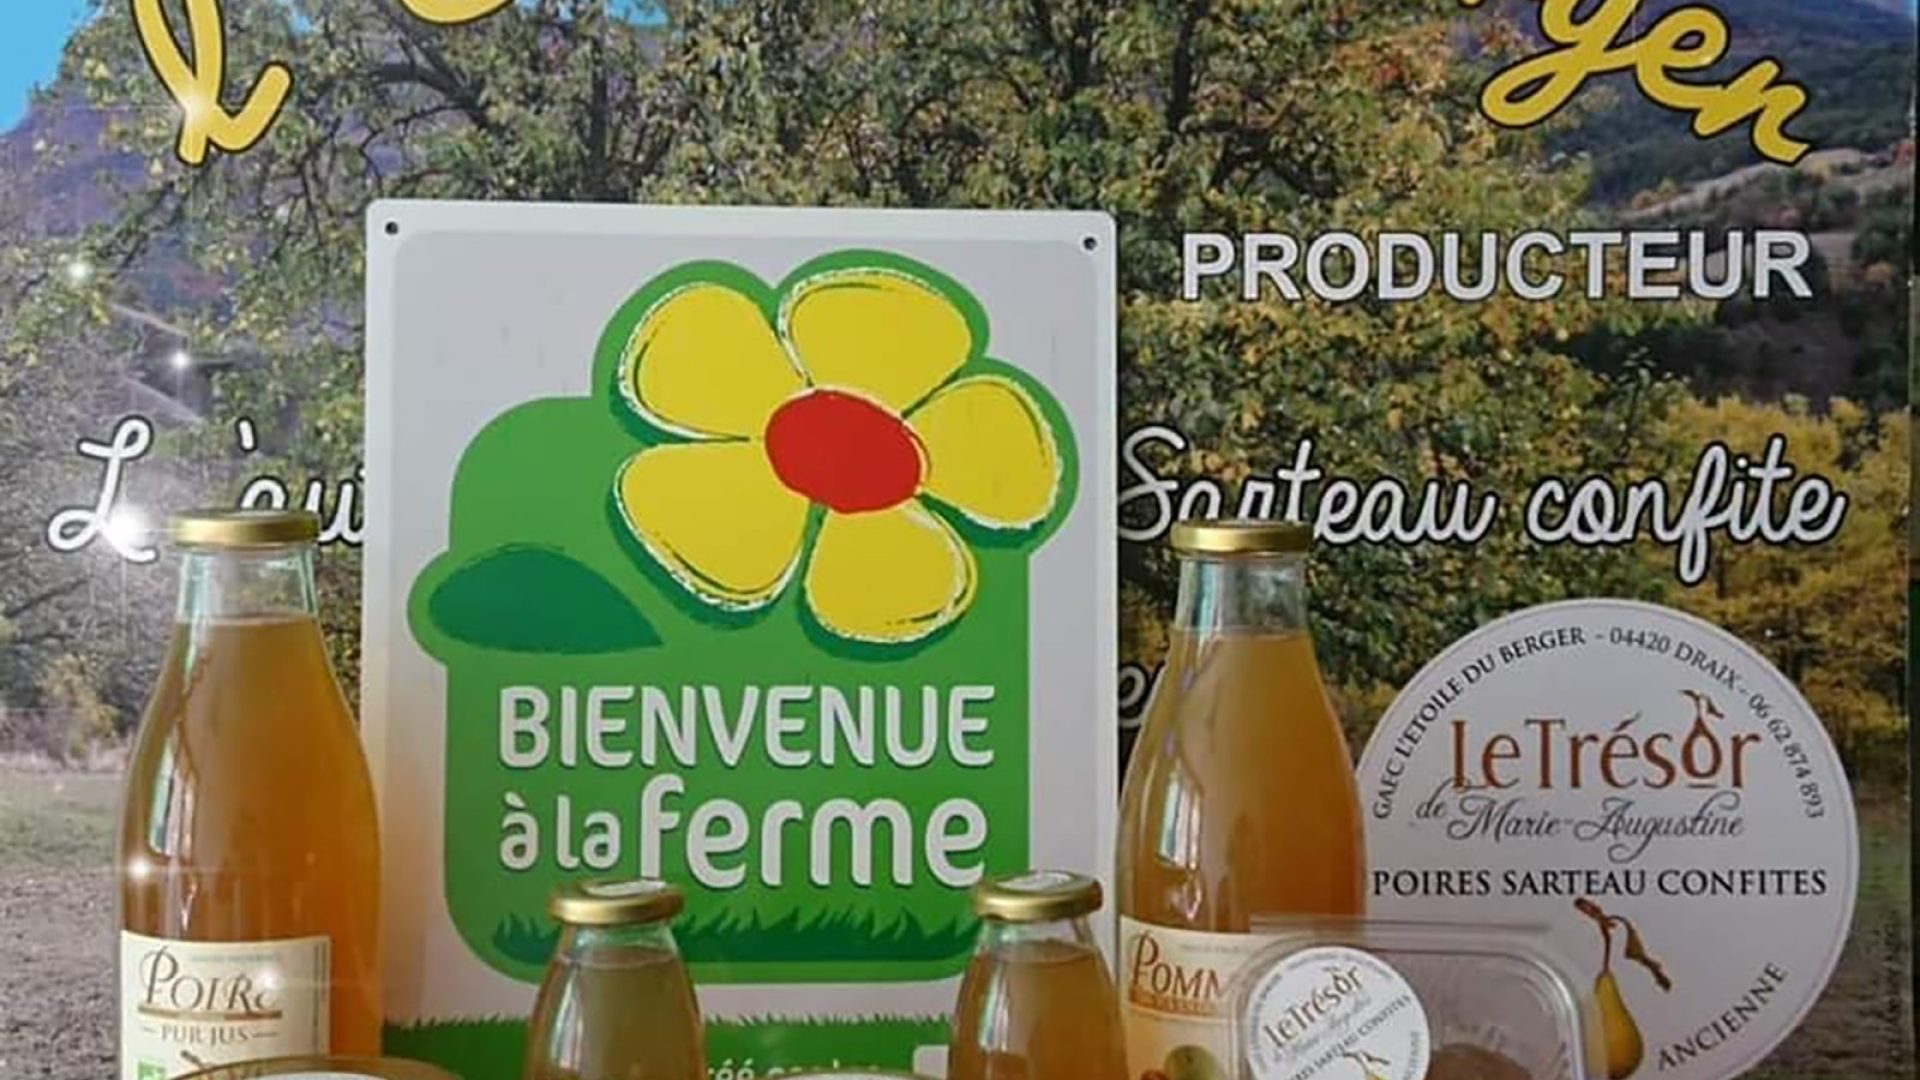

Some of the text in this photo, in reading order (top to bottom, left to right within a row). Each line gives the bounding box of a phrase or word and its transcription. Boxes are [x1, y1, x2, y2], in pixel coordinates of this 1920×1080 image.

[1182, 231, 1813, 301] PRODUCTEUR
[1117, 425, 1848, 587] Sarteau confite
[500, 685, 995, 768] BIENVENUE
[1372, 758, 1405, 819] GAEC
[1394, 676, 1464, 759] L'ETOILE
[1461, 653, 1497, 684] DU
[1498, 626, 1587, 664] BERGER
[1609, 626, 1671, 655] 04420
[1674, 641, 1742, 690] DRAIX
[1749, 692, 1771, 721] 06
[1766, 717, 1793, 745] 62
[1783, 742, 1812, 780] 874
[500, 772, 989, 889] à la ferme
[1415, 776, 1470, 820] de
[1372, 869, 1828, 896] POIRES SARTEAU CONFITES
[1127, 930, 1223, 1000] POMM
[209, 1025, 251, 1047] JUS
[1658, 962, 1788, 1072] ANCIENNE
